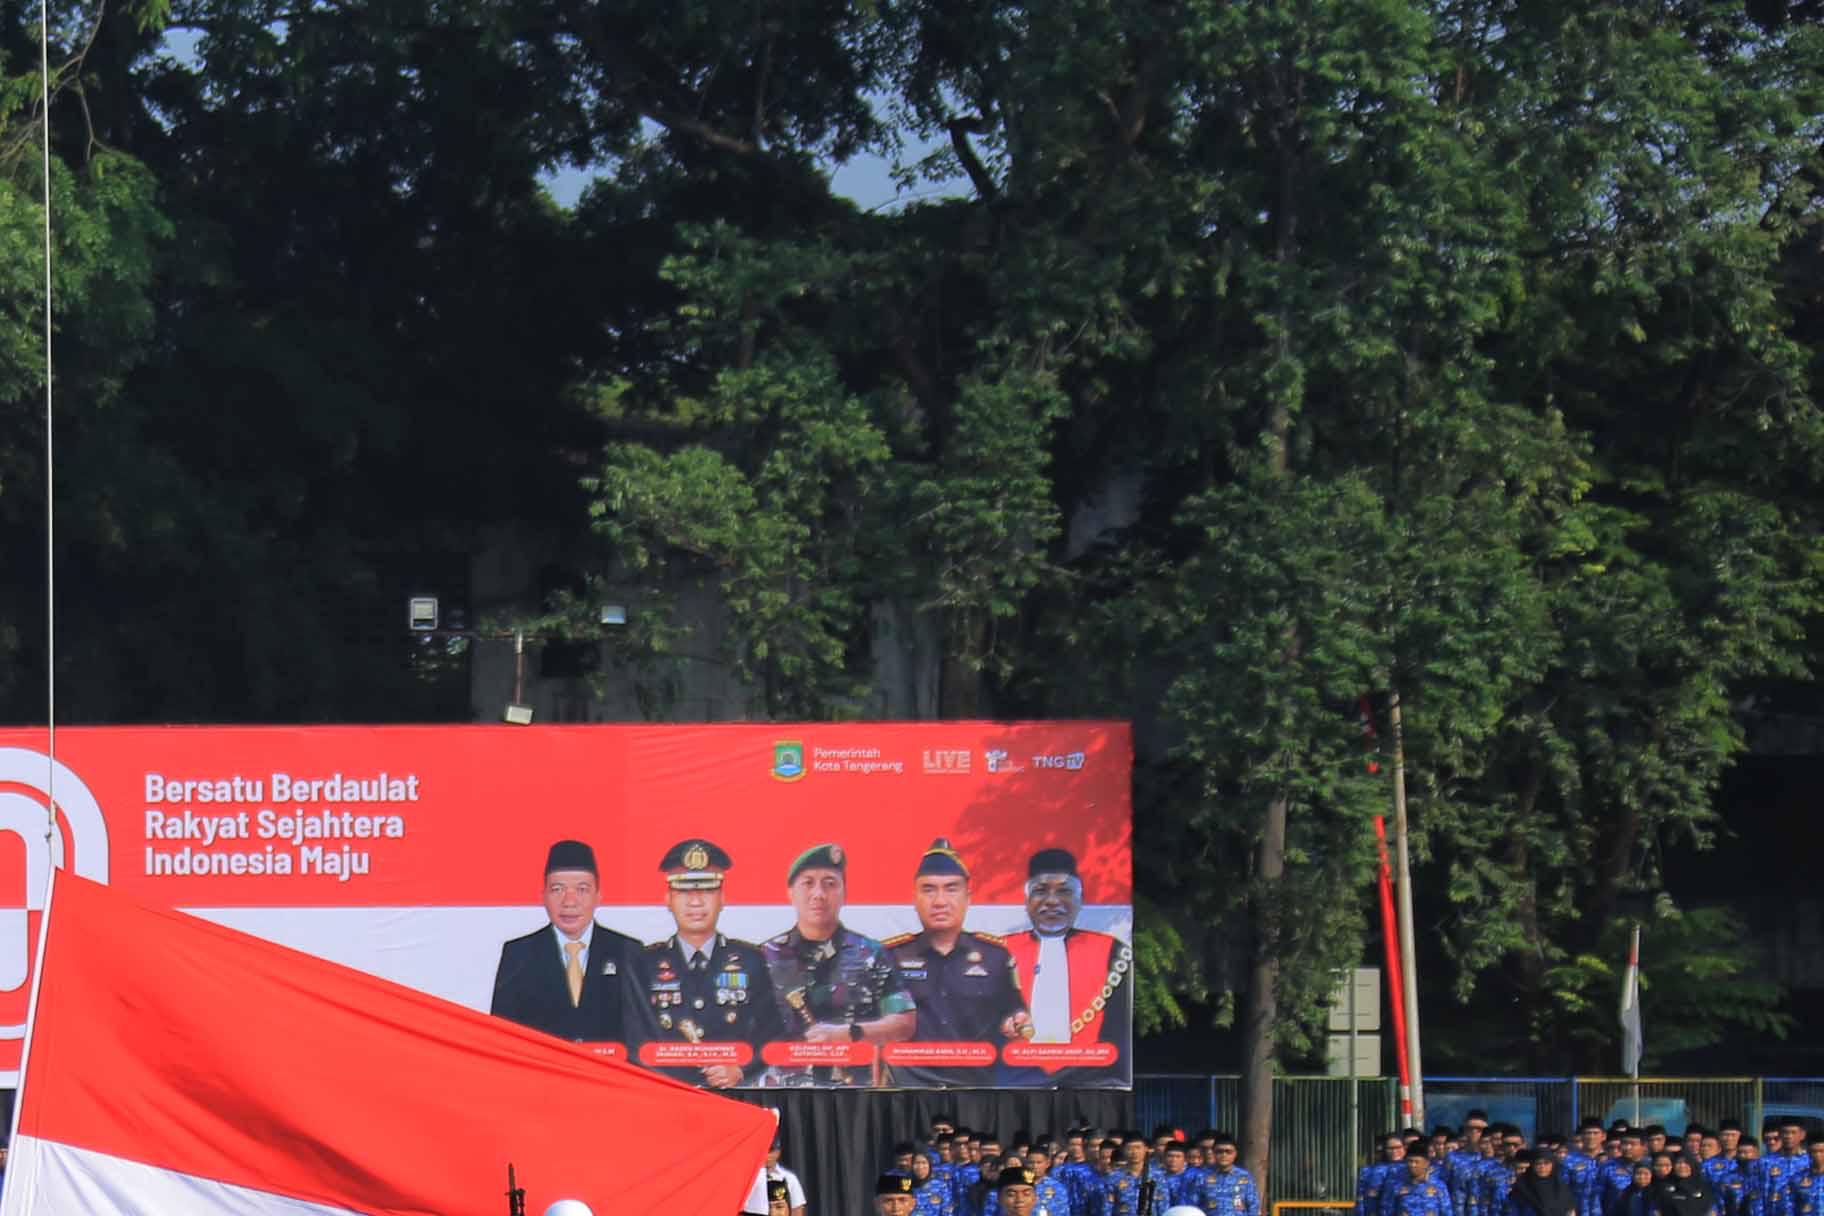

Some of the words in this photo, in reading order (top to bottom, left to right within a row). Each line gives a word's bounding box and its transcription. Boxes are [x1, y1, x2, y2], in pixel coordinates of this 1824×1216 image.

[813, 748, 881, 760] Pemerintah
[922, 750, 972, 769] LIVE
[813, 761, 841, 772] Kota
[843, 760, 904, 775] Tangerang
[144, 774, 264, 803] Bersatu
[271, 773, 420, 802] Berdaulat
[144, 810, 250, 847] Rakyat
[256, 808, 404, 846] Sejahtera
[144, 845, 293, 876] Indonesia
[300, 845, 370, 882] Maju
